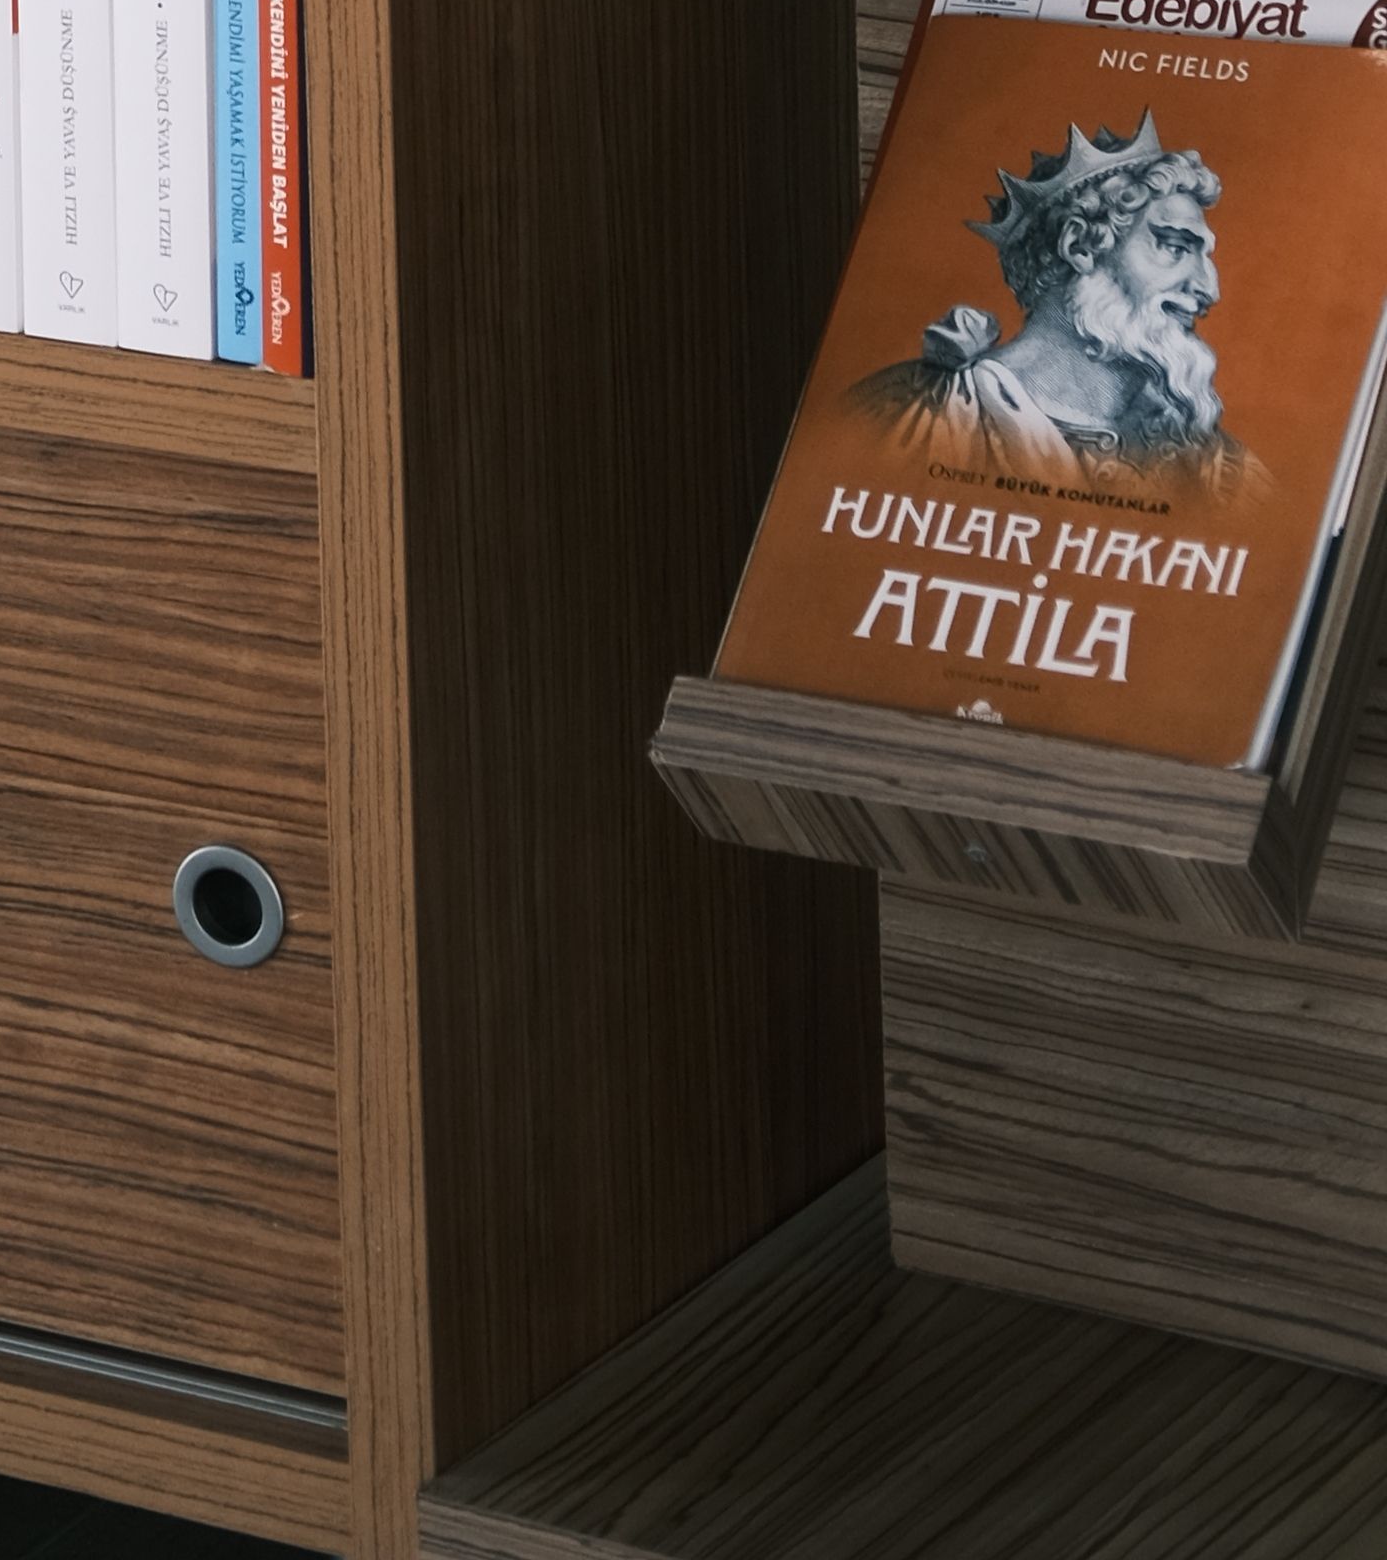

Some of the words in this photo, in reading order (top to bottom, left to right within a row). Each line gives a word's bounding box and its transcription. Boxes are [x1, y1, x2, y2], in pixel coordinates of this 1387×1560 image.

[1099, 49, 1147, 73] NIC
[1157, 54, 1249, 82] FIELDS
[267, 83, 290, 170] YENİDEN
[267, 174, 291, 249] BAŞLAT
[995, 473, 1052, 497] BÜYÜK
[1057, 483, 1171, 515] KOMUTANLAR
[822, 486, 1040, 567] HUNLAR
[1049, 518, 1248, 598] HAKANI
[853, 568, 1135, 682] ATTİLA
